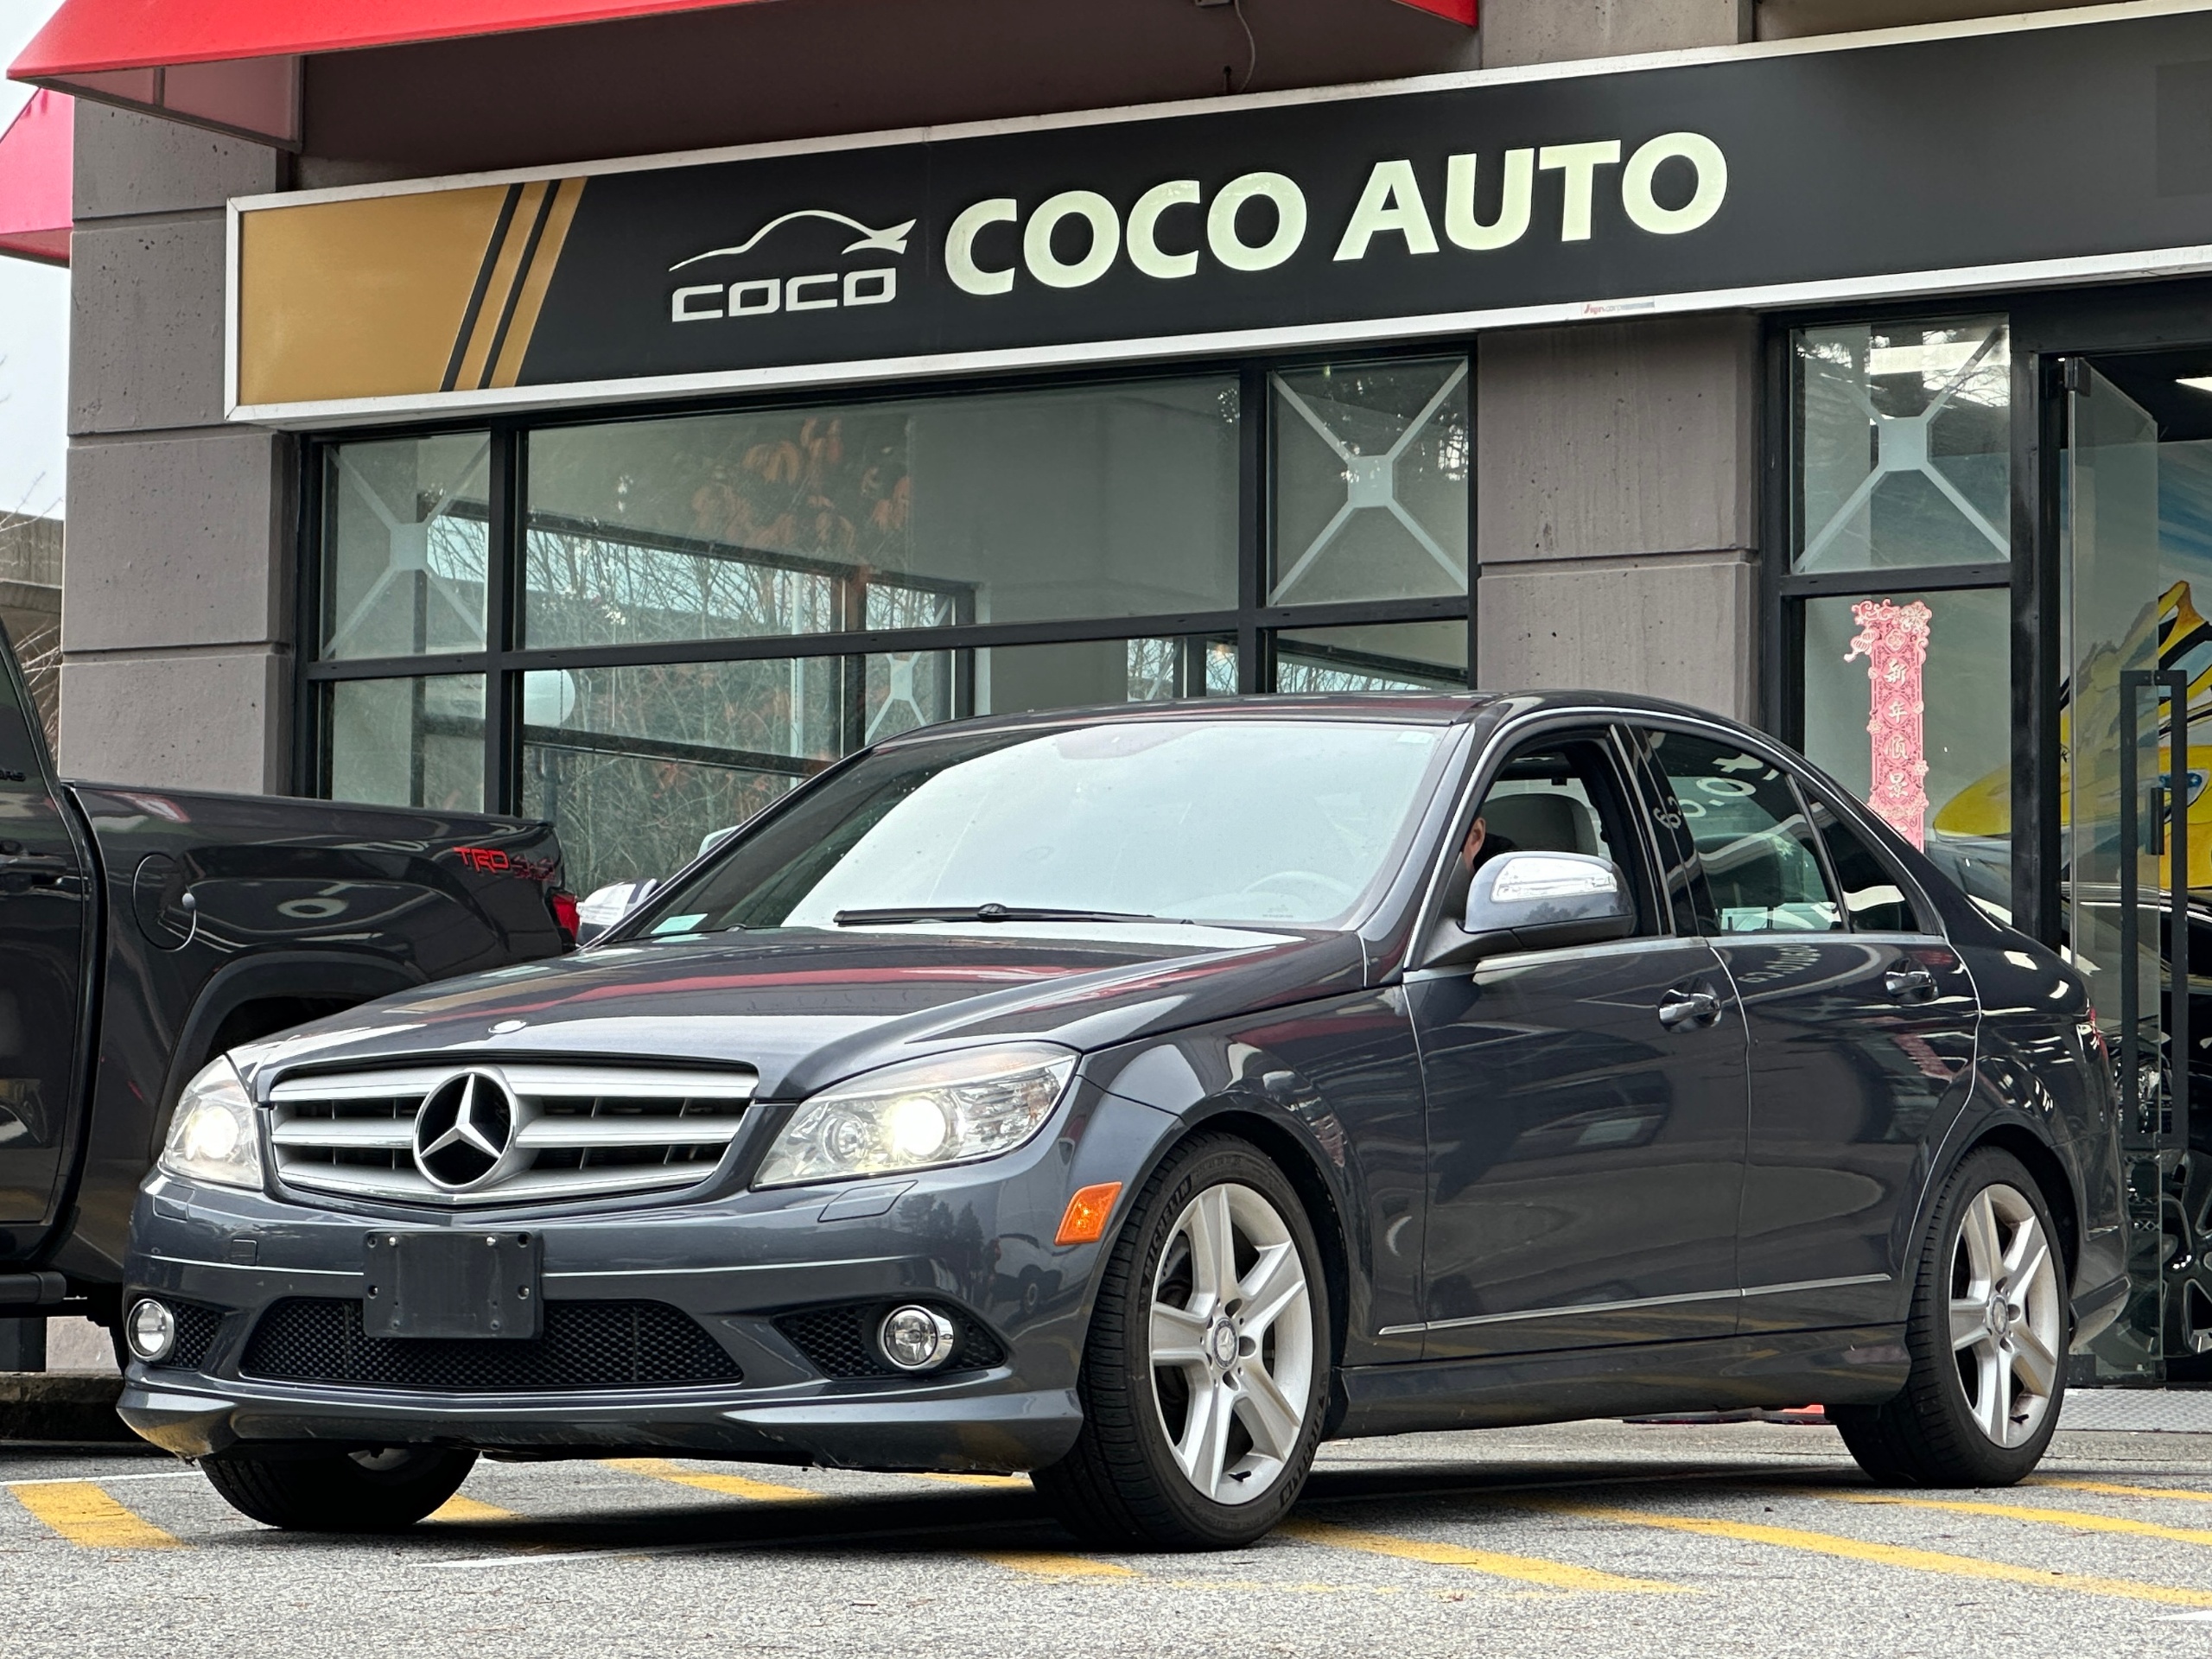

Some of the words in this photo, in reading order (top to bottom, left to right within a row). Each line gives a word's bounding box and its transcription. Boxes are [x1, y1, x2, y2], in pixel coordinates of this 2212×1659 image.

[944, 171, 1307, 296] COCO
[1332, 131, 1728, 262] AUTO
[672, 268, 896, 321] COCO
[454, 846, 510, 874] TRD
[1144, 1176, 1192, 1280] MICHELIN
